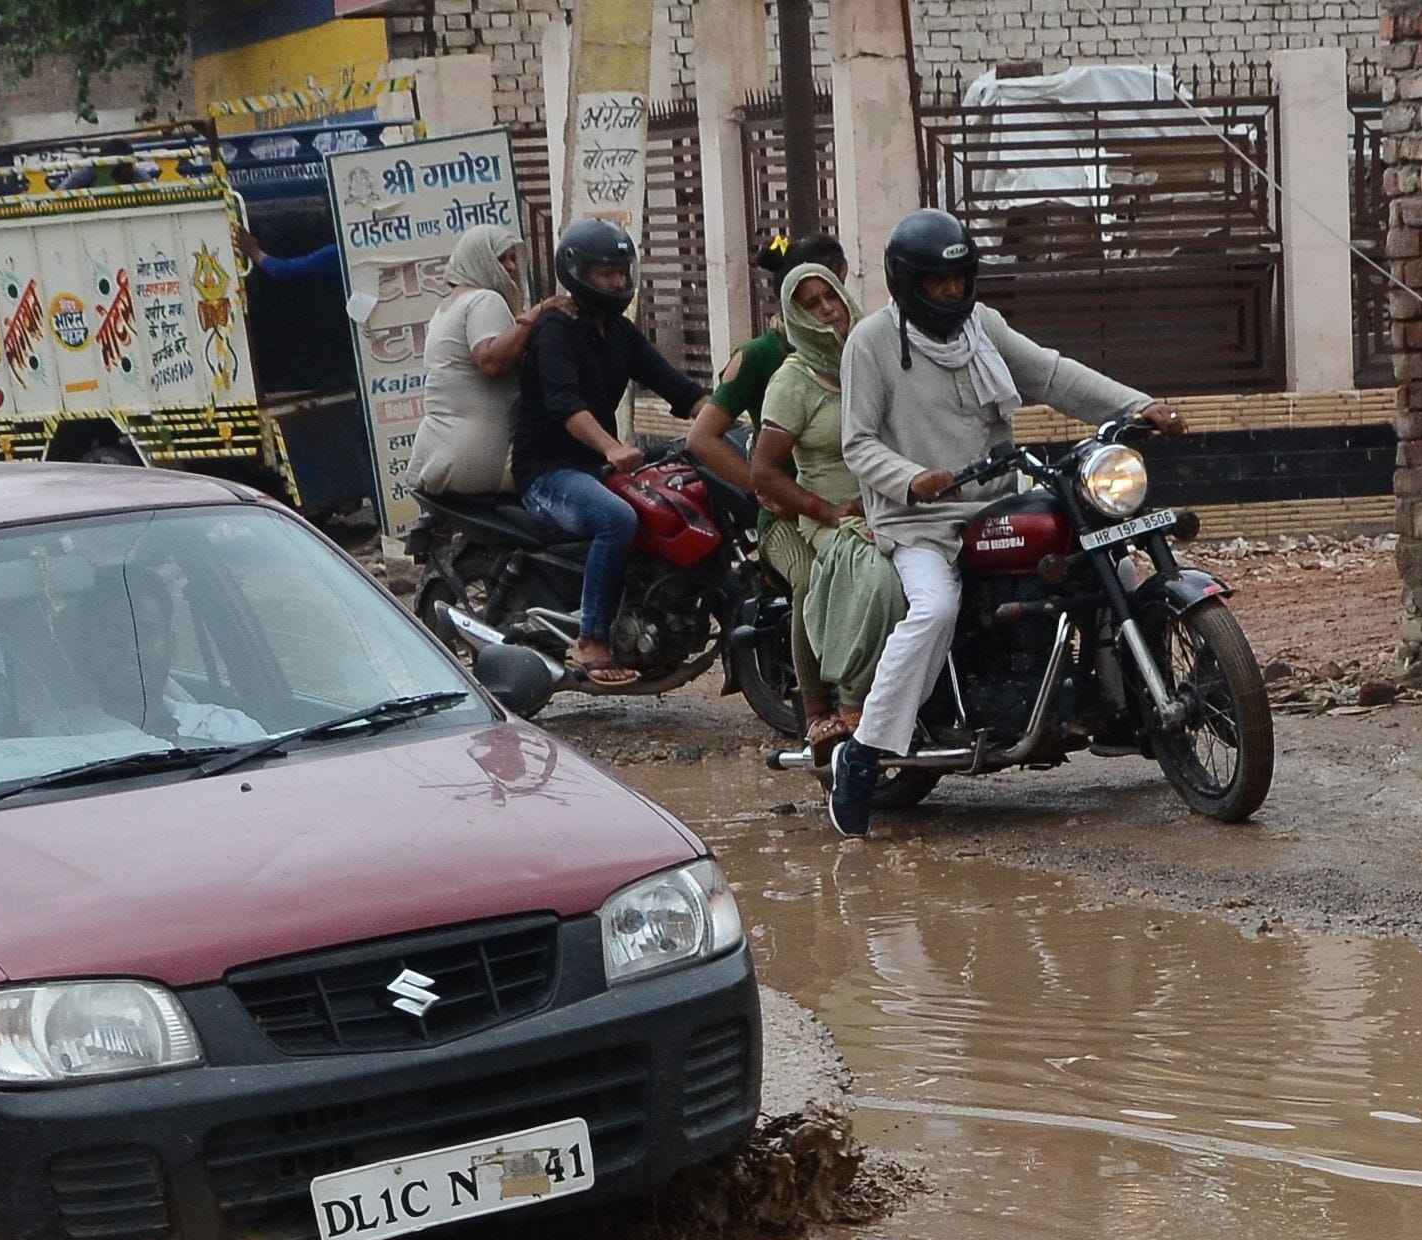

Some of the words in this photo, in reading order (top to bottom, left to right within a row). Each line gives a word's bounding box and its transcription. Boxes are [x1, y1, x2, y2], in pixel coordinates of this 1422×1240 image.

[382, 159, 416, 195] श्री
[419, 152, 501, 189] गणेश
[583, 140, 639, 170] बोलना
[347, 211, 410, 248] टाईल्स
[1095, 530, 1111, 545] HR
[321, 1180, 431, 1238] DL1C
